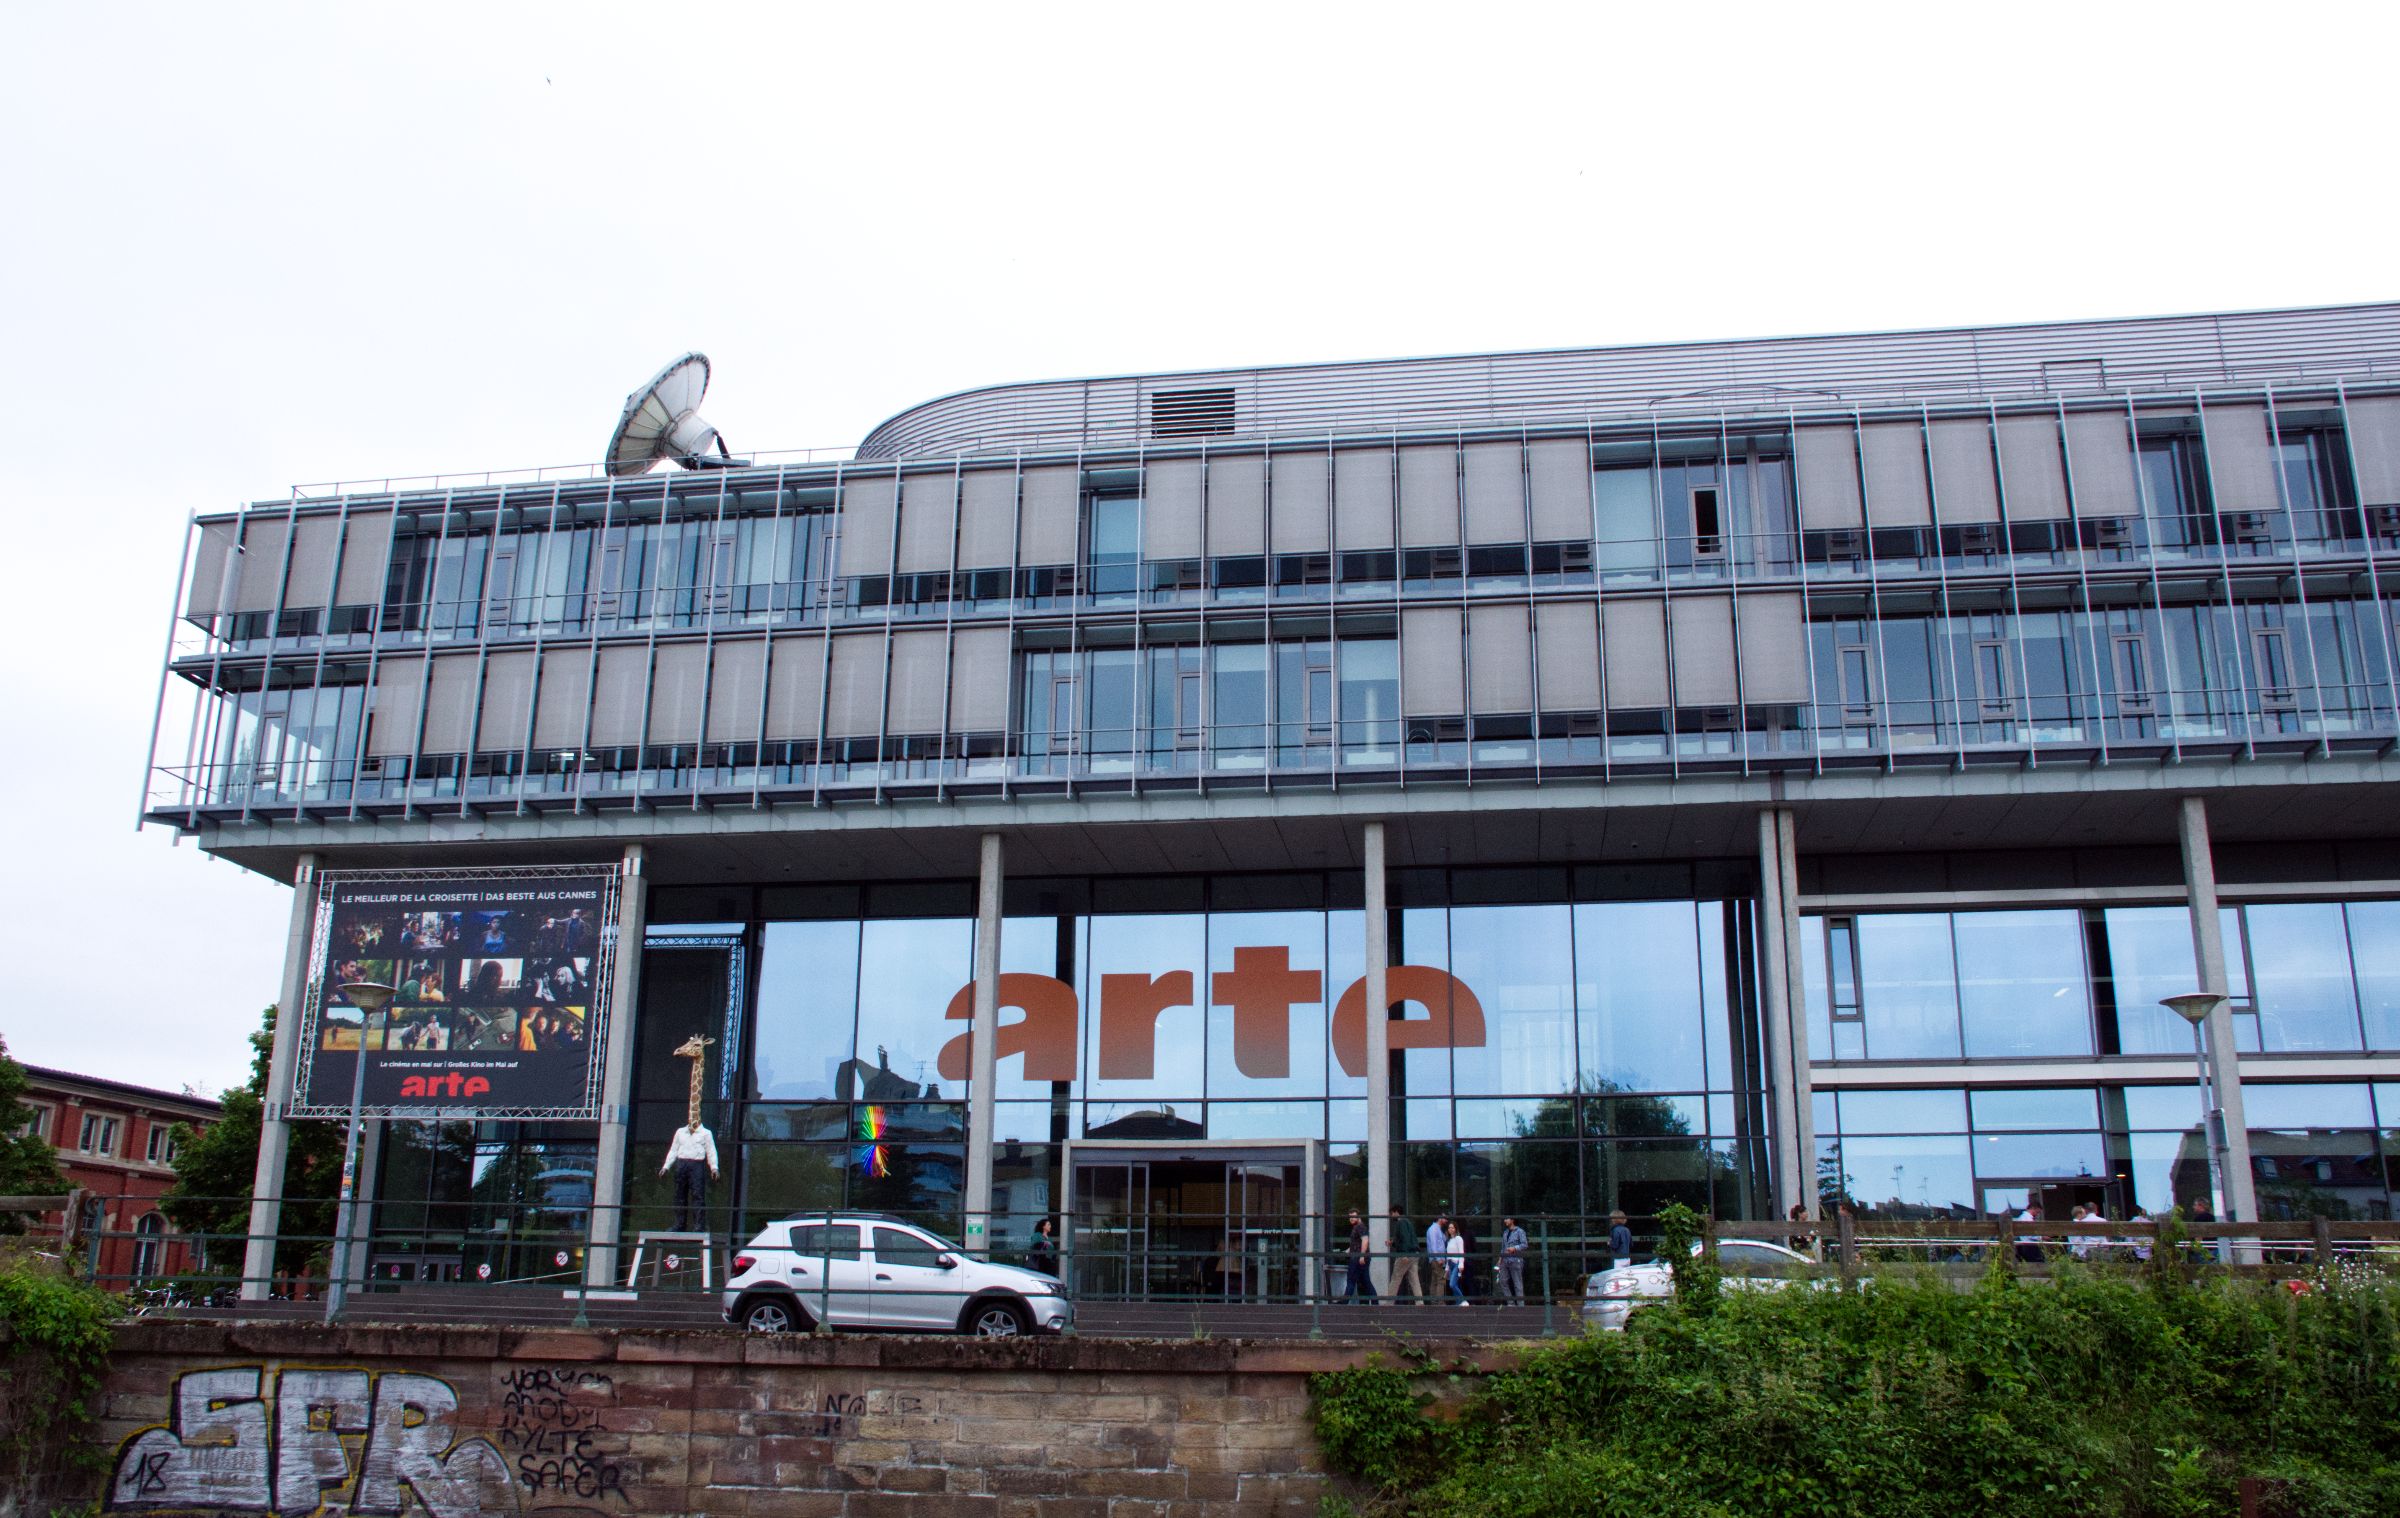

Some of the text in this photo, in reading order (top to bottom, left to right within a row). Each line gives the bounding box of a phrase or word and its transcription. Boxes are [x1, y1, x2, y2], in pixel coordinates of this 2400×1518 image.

[354, 894, 398, 903] MEILLEUR
[400, 894, 413, 902] DE
[414, 893, 427, 902] LA
[428, 893, 479, 902] CROISETTE
[485, 892, 505, 901] DAS
[506, 892, 535, 900] BESTE
[537, 891, 557, 900] AUS
[558, 891, 597, 900] CANNES
[937, 946, 1487, 1082] arte
[400, 1072, 491, 1097] arte
